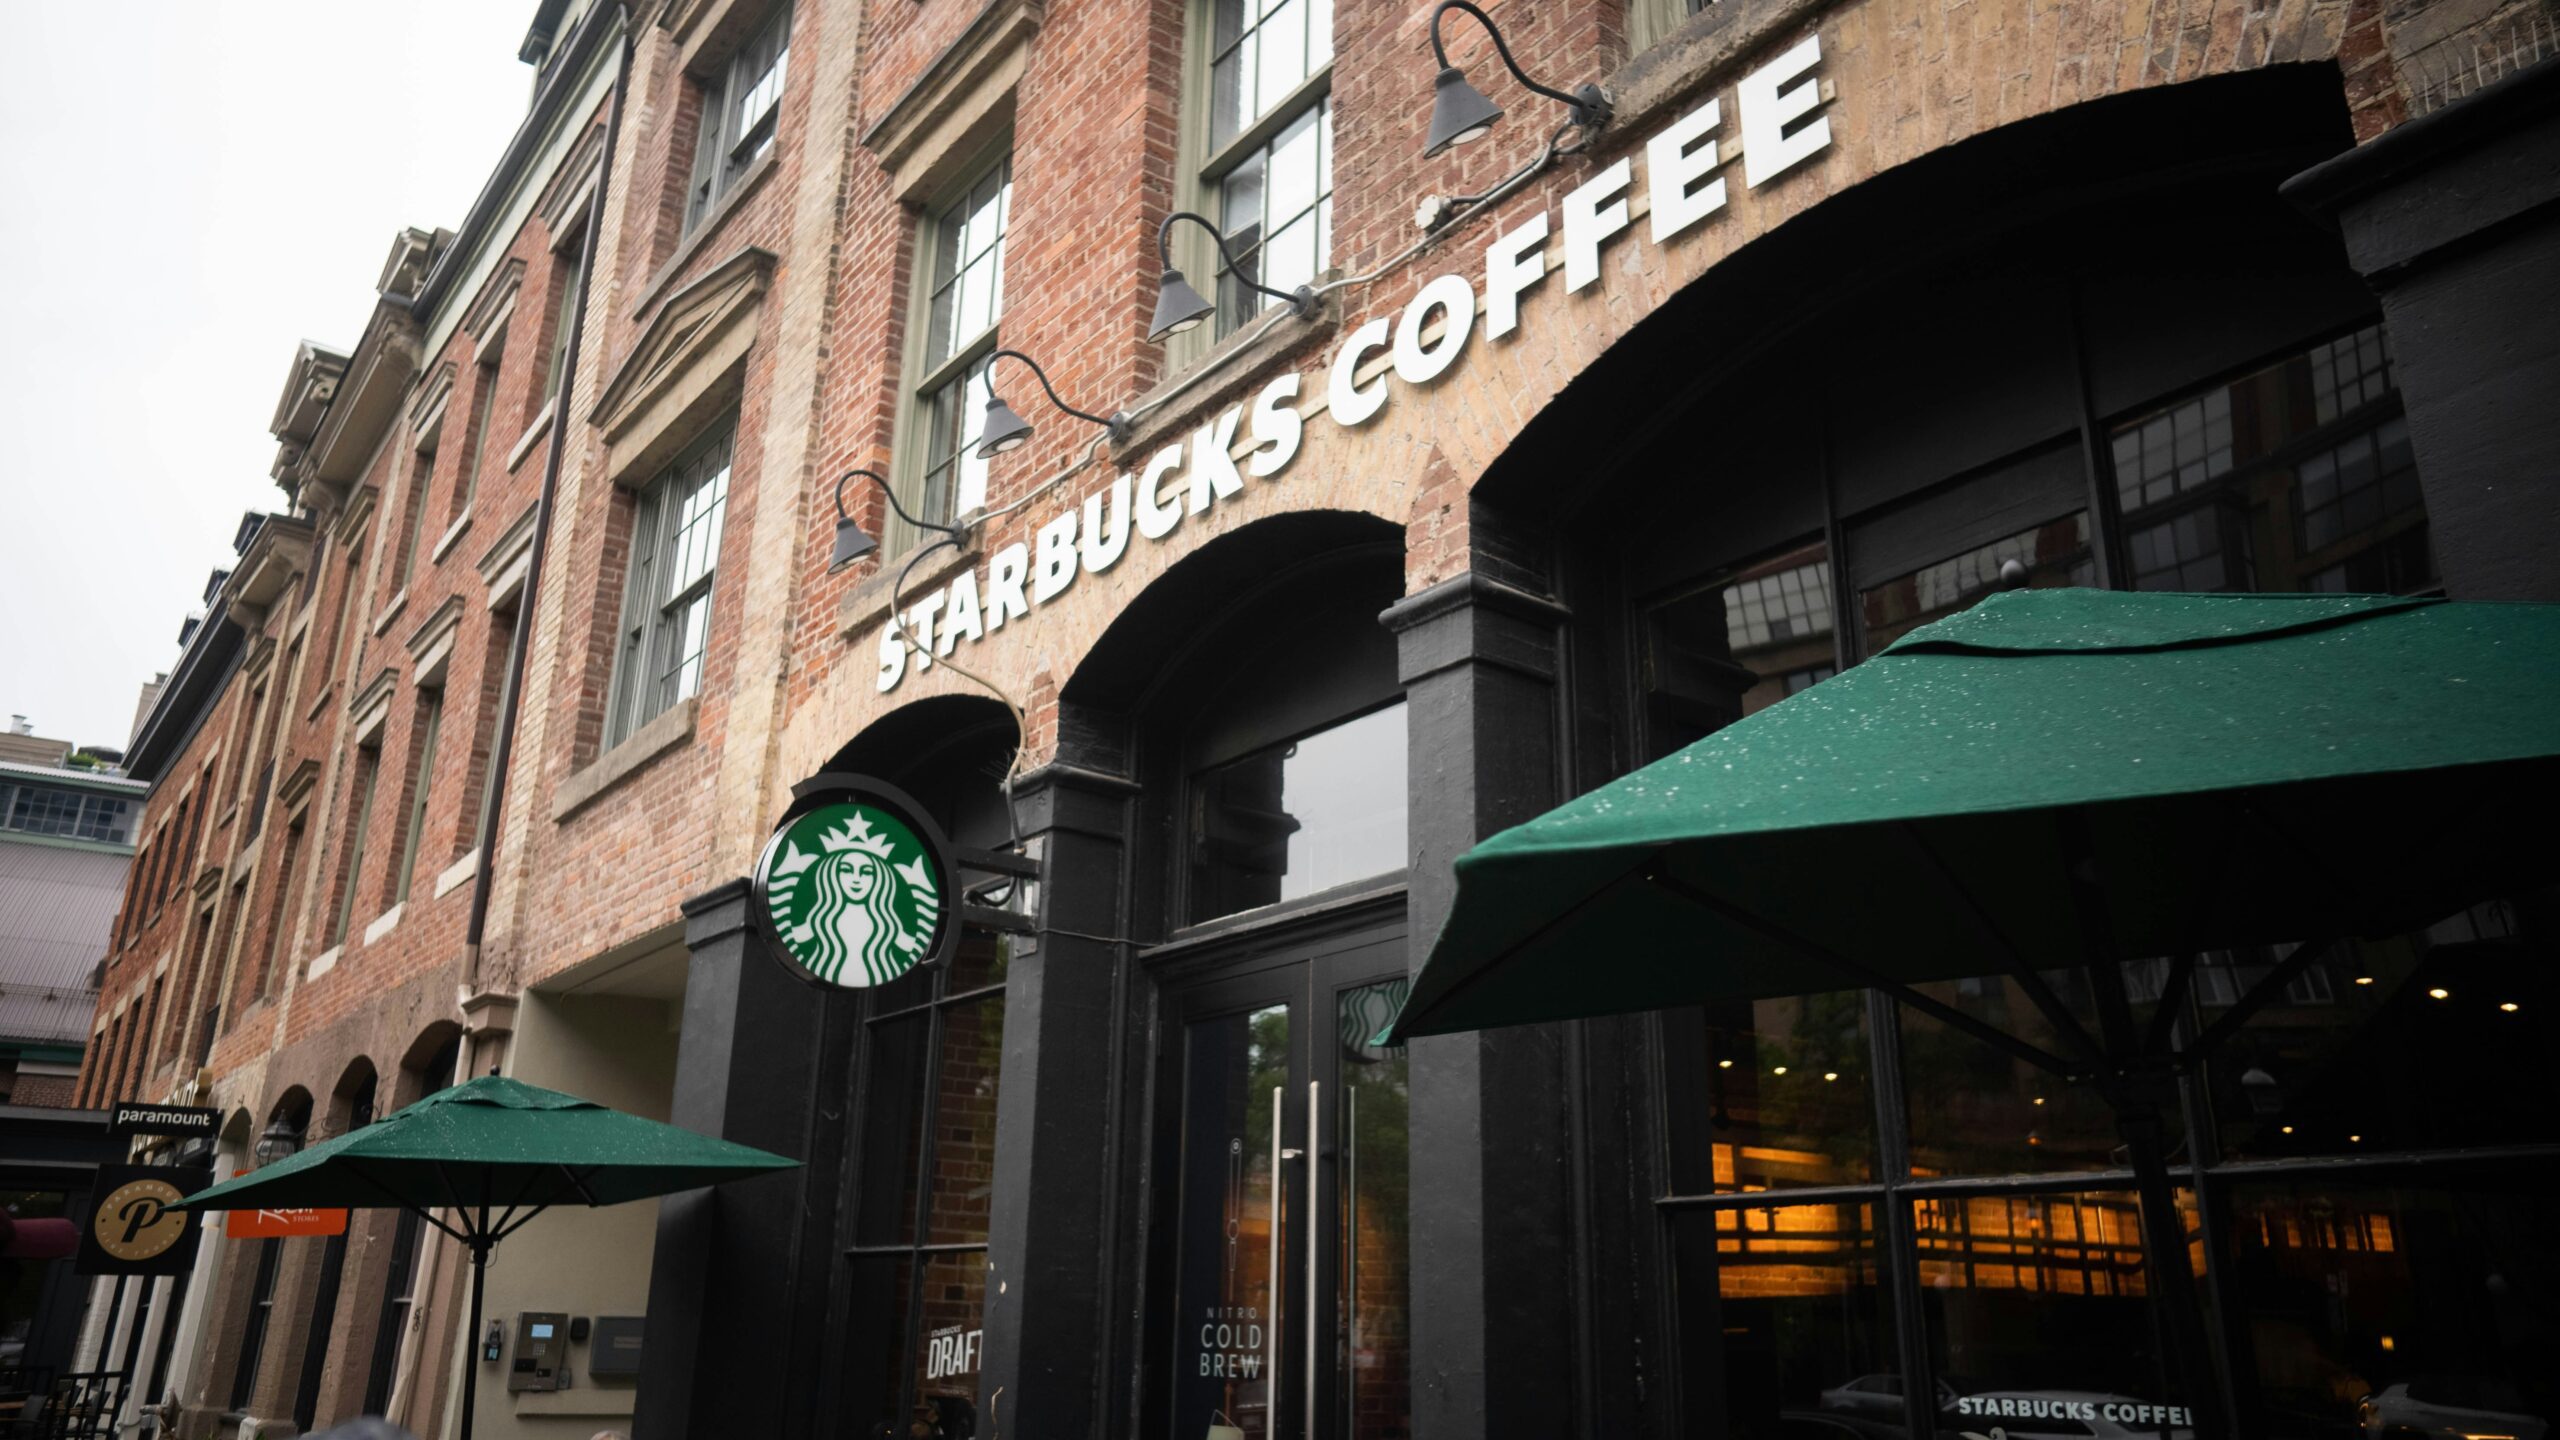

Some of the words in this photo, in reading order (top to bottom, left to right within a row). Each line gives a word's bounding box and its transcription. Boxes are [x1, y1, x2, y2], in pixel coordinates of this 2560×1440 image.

[876, 371, 1304, 694] STARBUCKS
[1327, 33, 1833, 427] COFFEE
[117, 1109, 210, 1126] paramount
[1206, 1307, 1257, 1319] NITRO
[1201, 1324, 1262, 1349] COLD
[1200, 1353, 1261, 1379] BREW
[1958, 1397, 2096, 1421] STARBUCKS
